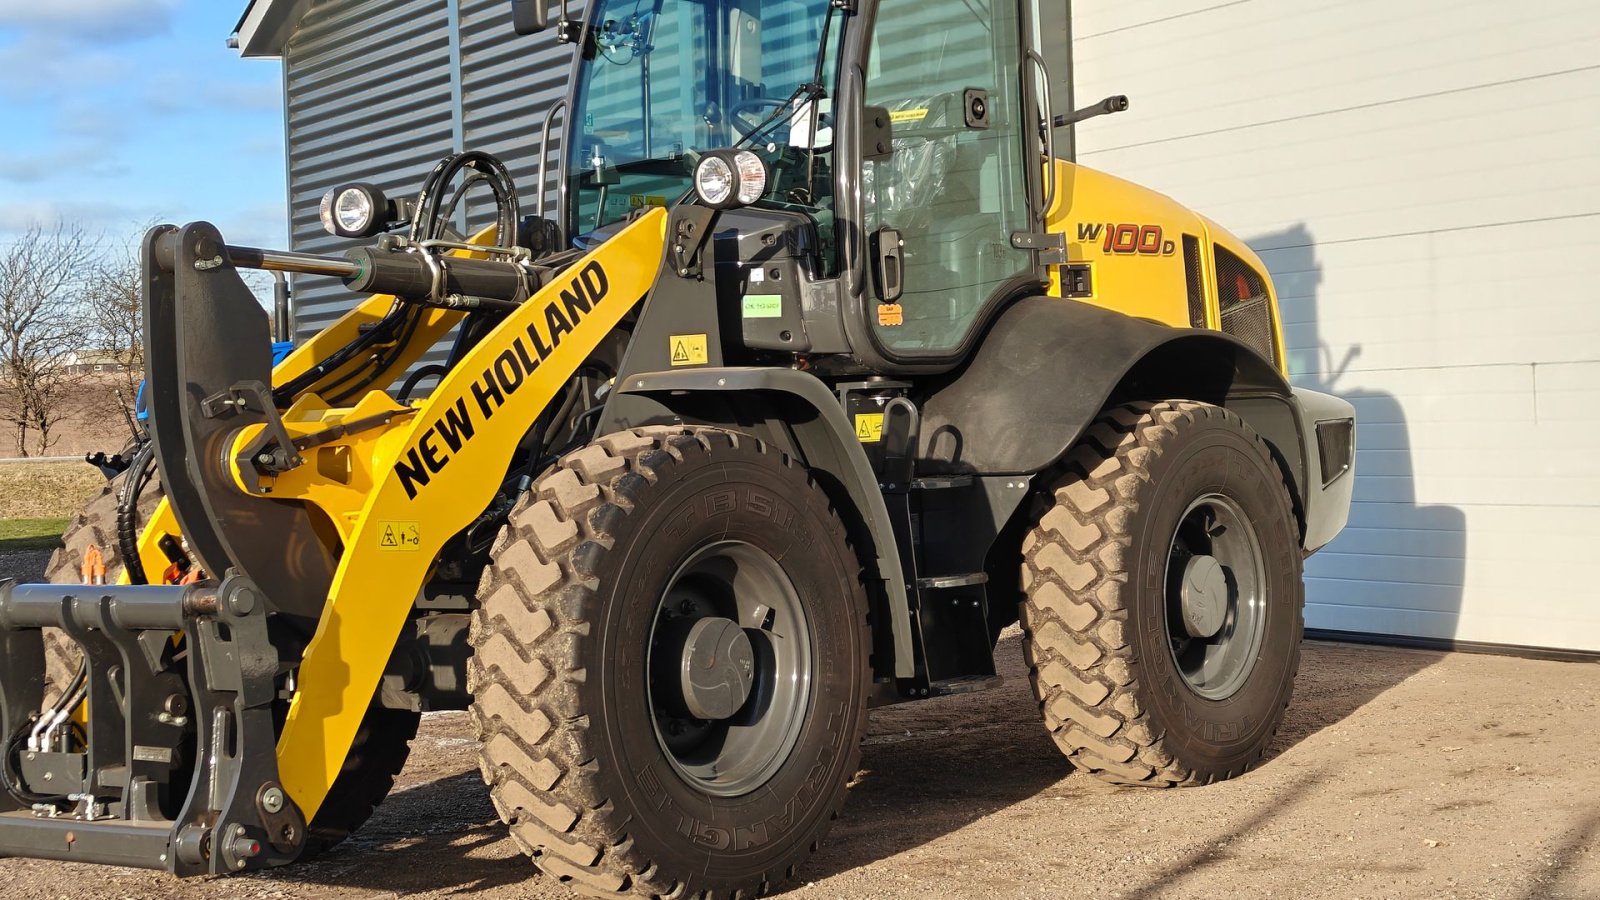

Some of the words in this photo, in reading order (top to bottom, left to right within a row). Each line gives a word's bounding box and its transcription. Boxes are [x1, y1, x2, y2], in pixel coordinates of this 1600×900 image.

[393, 396, 475, 501] NEW
[470, 259, 609, 421] HOLLAND
[636, 701, 850, 852] TRIANGLE
